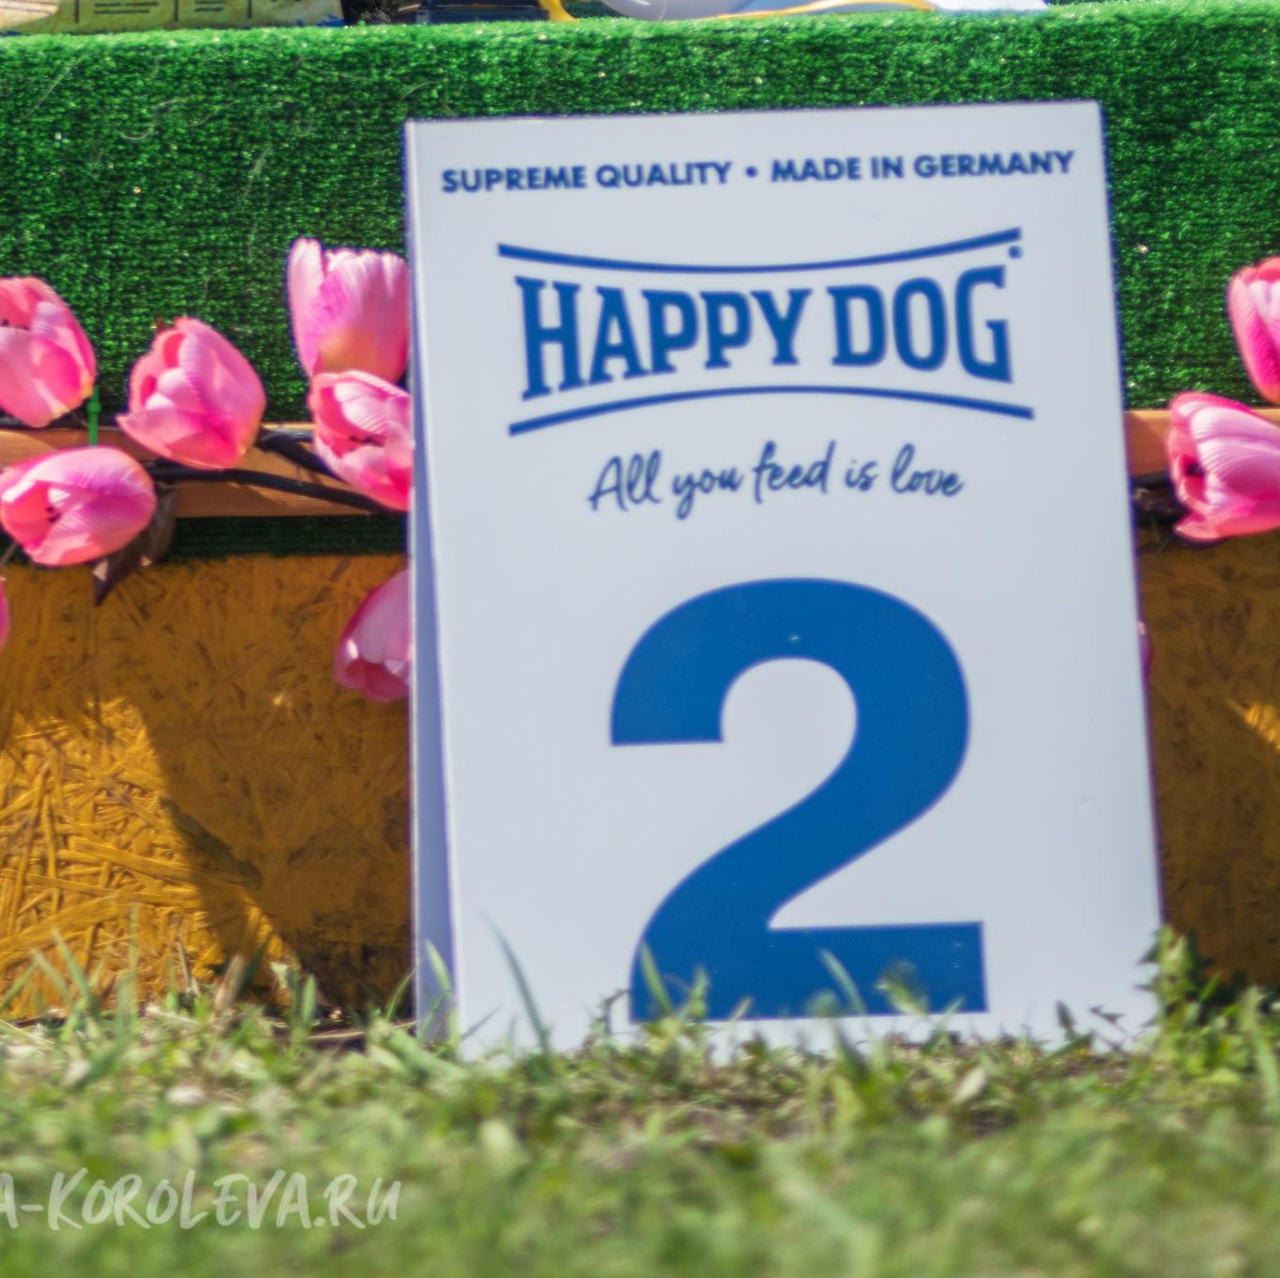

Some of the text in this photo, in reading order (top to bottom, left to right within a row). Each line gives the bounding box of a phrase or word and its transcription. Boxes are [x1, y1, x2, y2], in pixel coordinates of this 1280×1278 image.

[441, 150, 1075, 193] SUPREME QUALITY MADE IN GERMANY
[515, 264, 1013, 401] HAPPY DOG
[587, 440, 964, 521] All you feed is love
[610, 577, 989, 1025] 2
